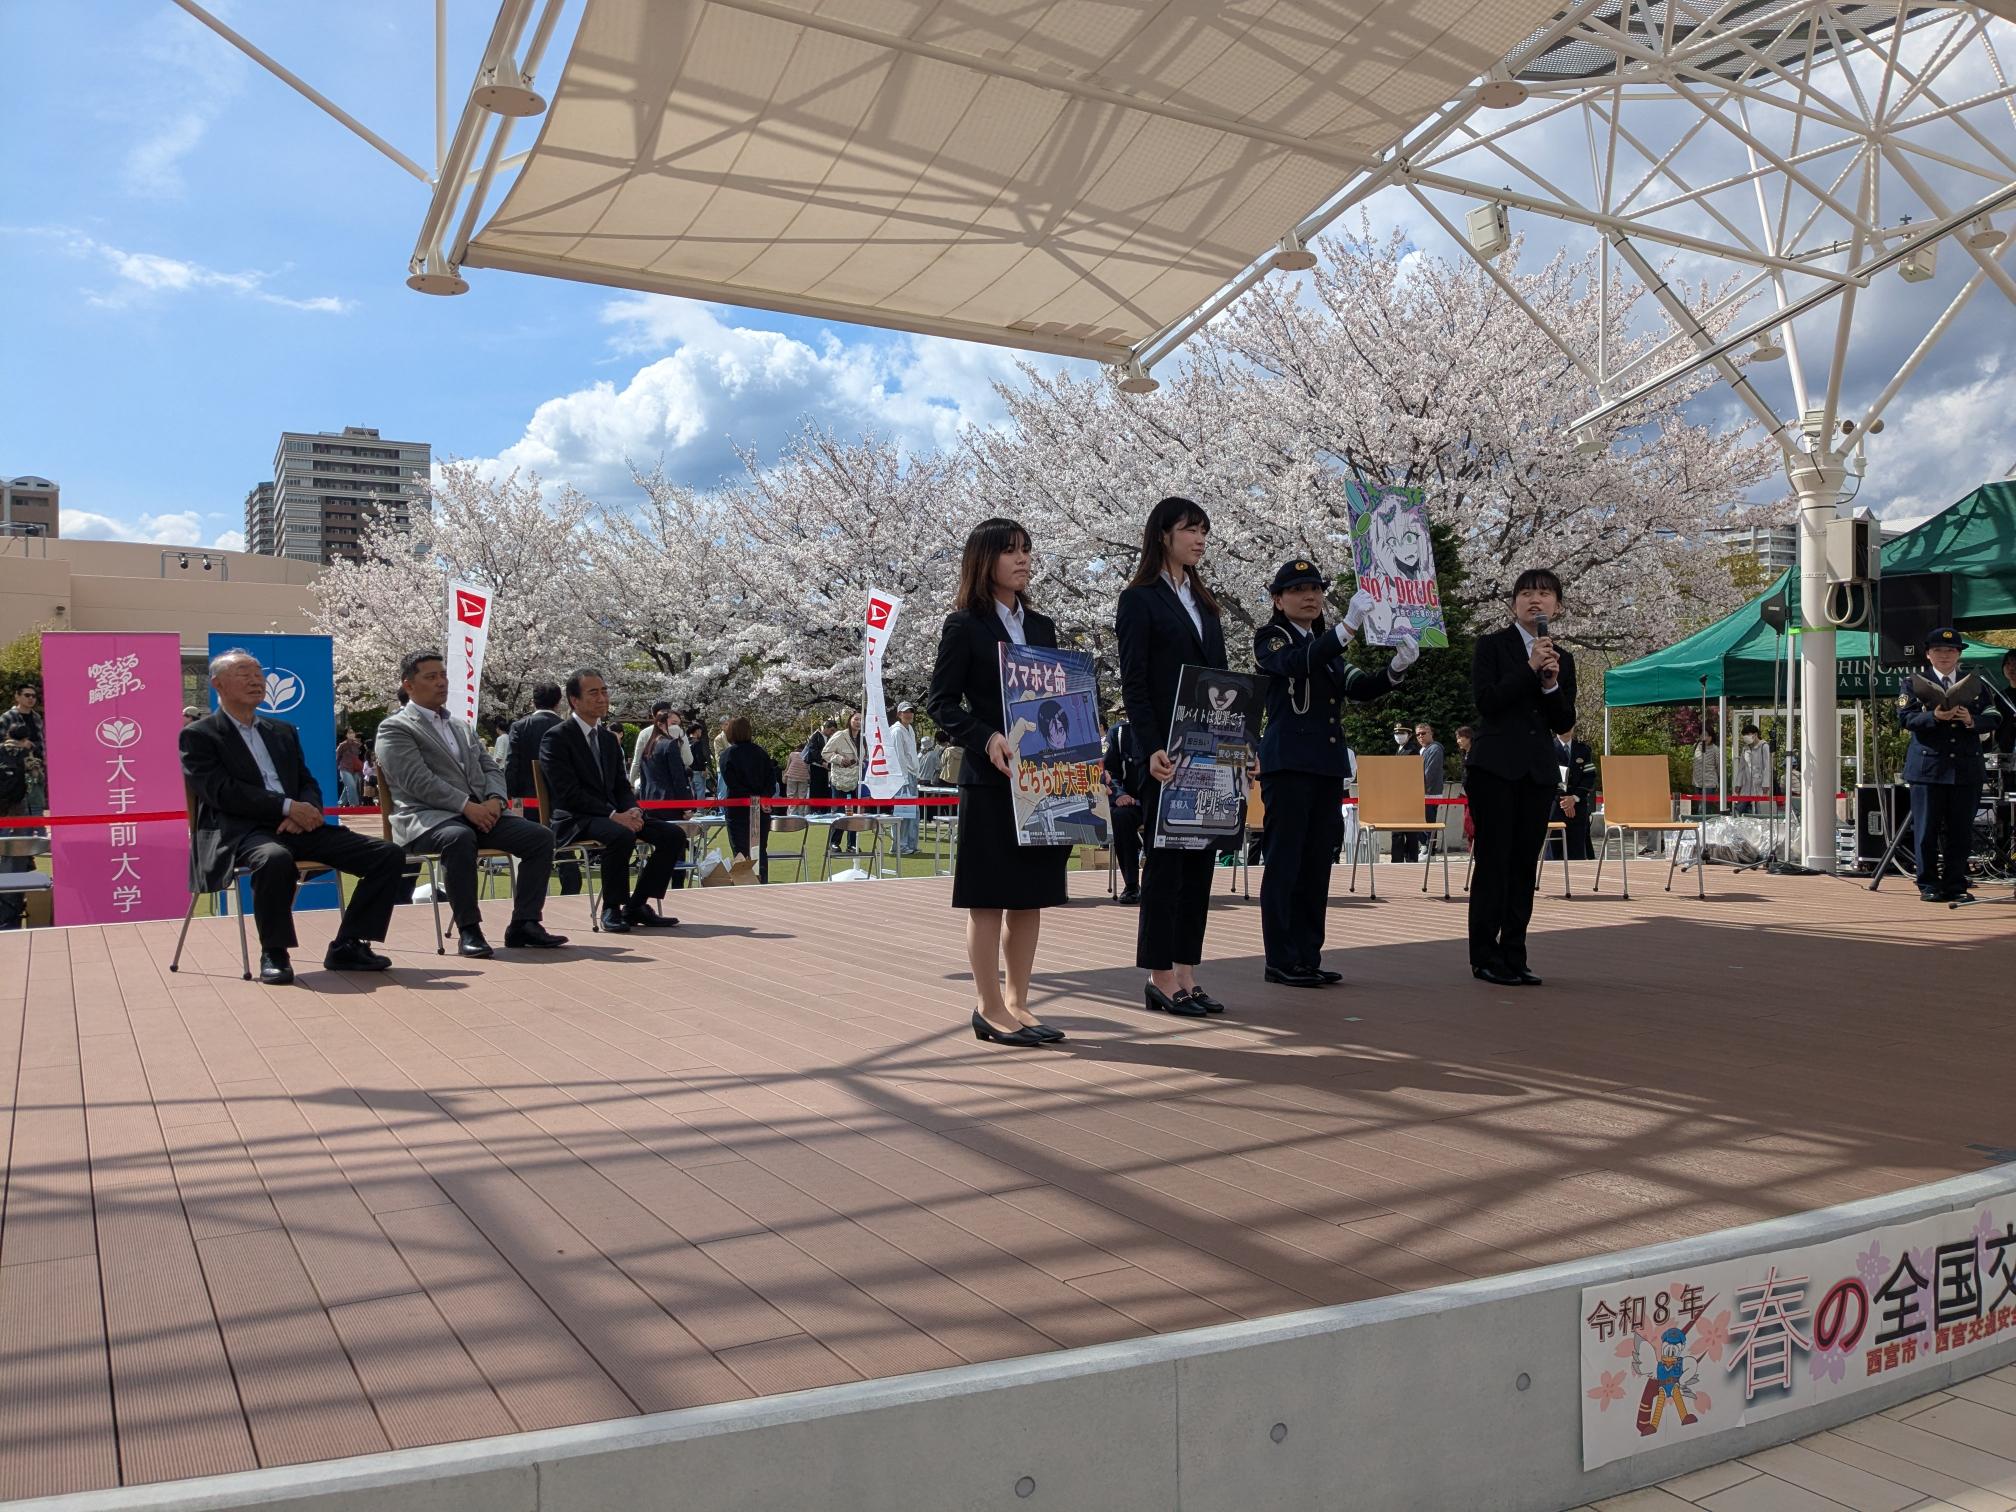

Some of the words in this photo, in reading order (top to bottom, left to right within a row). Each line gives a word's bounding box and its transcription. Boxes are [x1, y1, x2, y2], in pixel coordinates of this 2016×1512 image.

[1394, 576, 1439, 608] DRUG
[88, 653, 139, 678] ゆさぶる
[1008, 661, 1066, 696] スマホと命
[1175, 705, 1246, 727] 闇バイトは犯罪です
[1194, 789, 1245, 816] 犯罪です
[105, 754, 142, 913] 大手前大学
[1587, 1283, 1705, 1343] 令和8年
